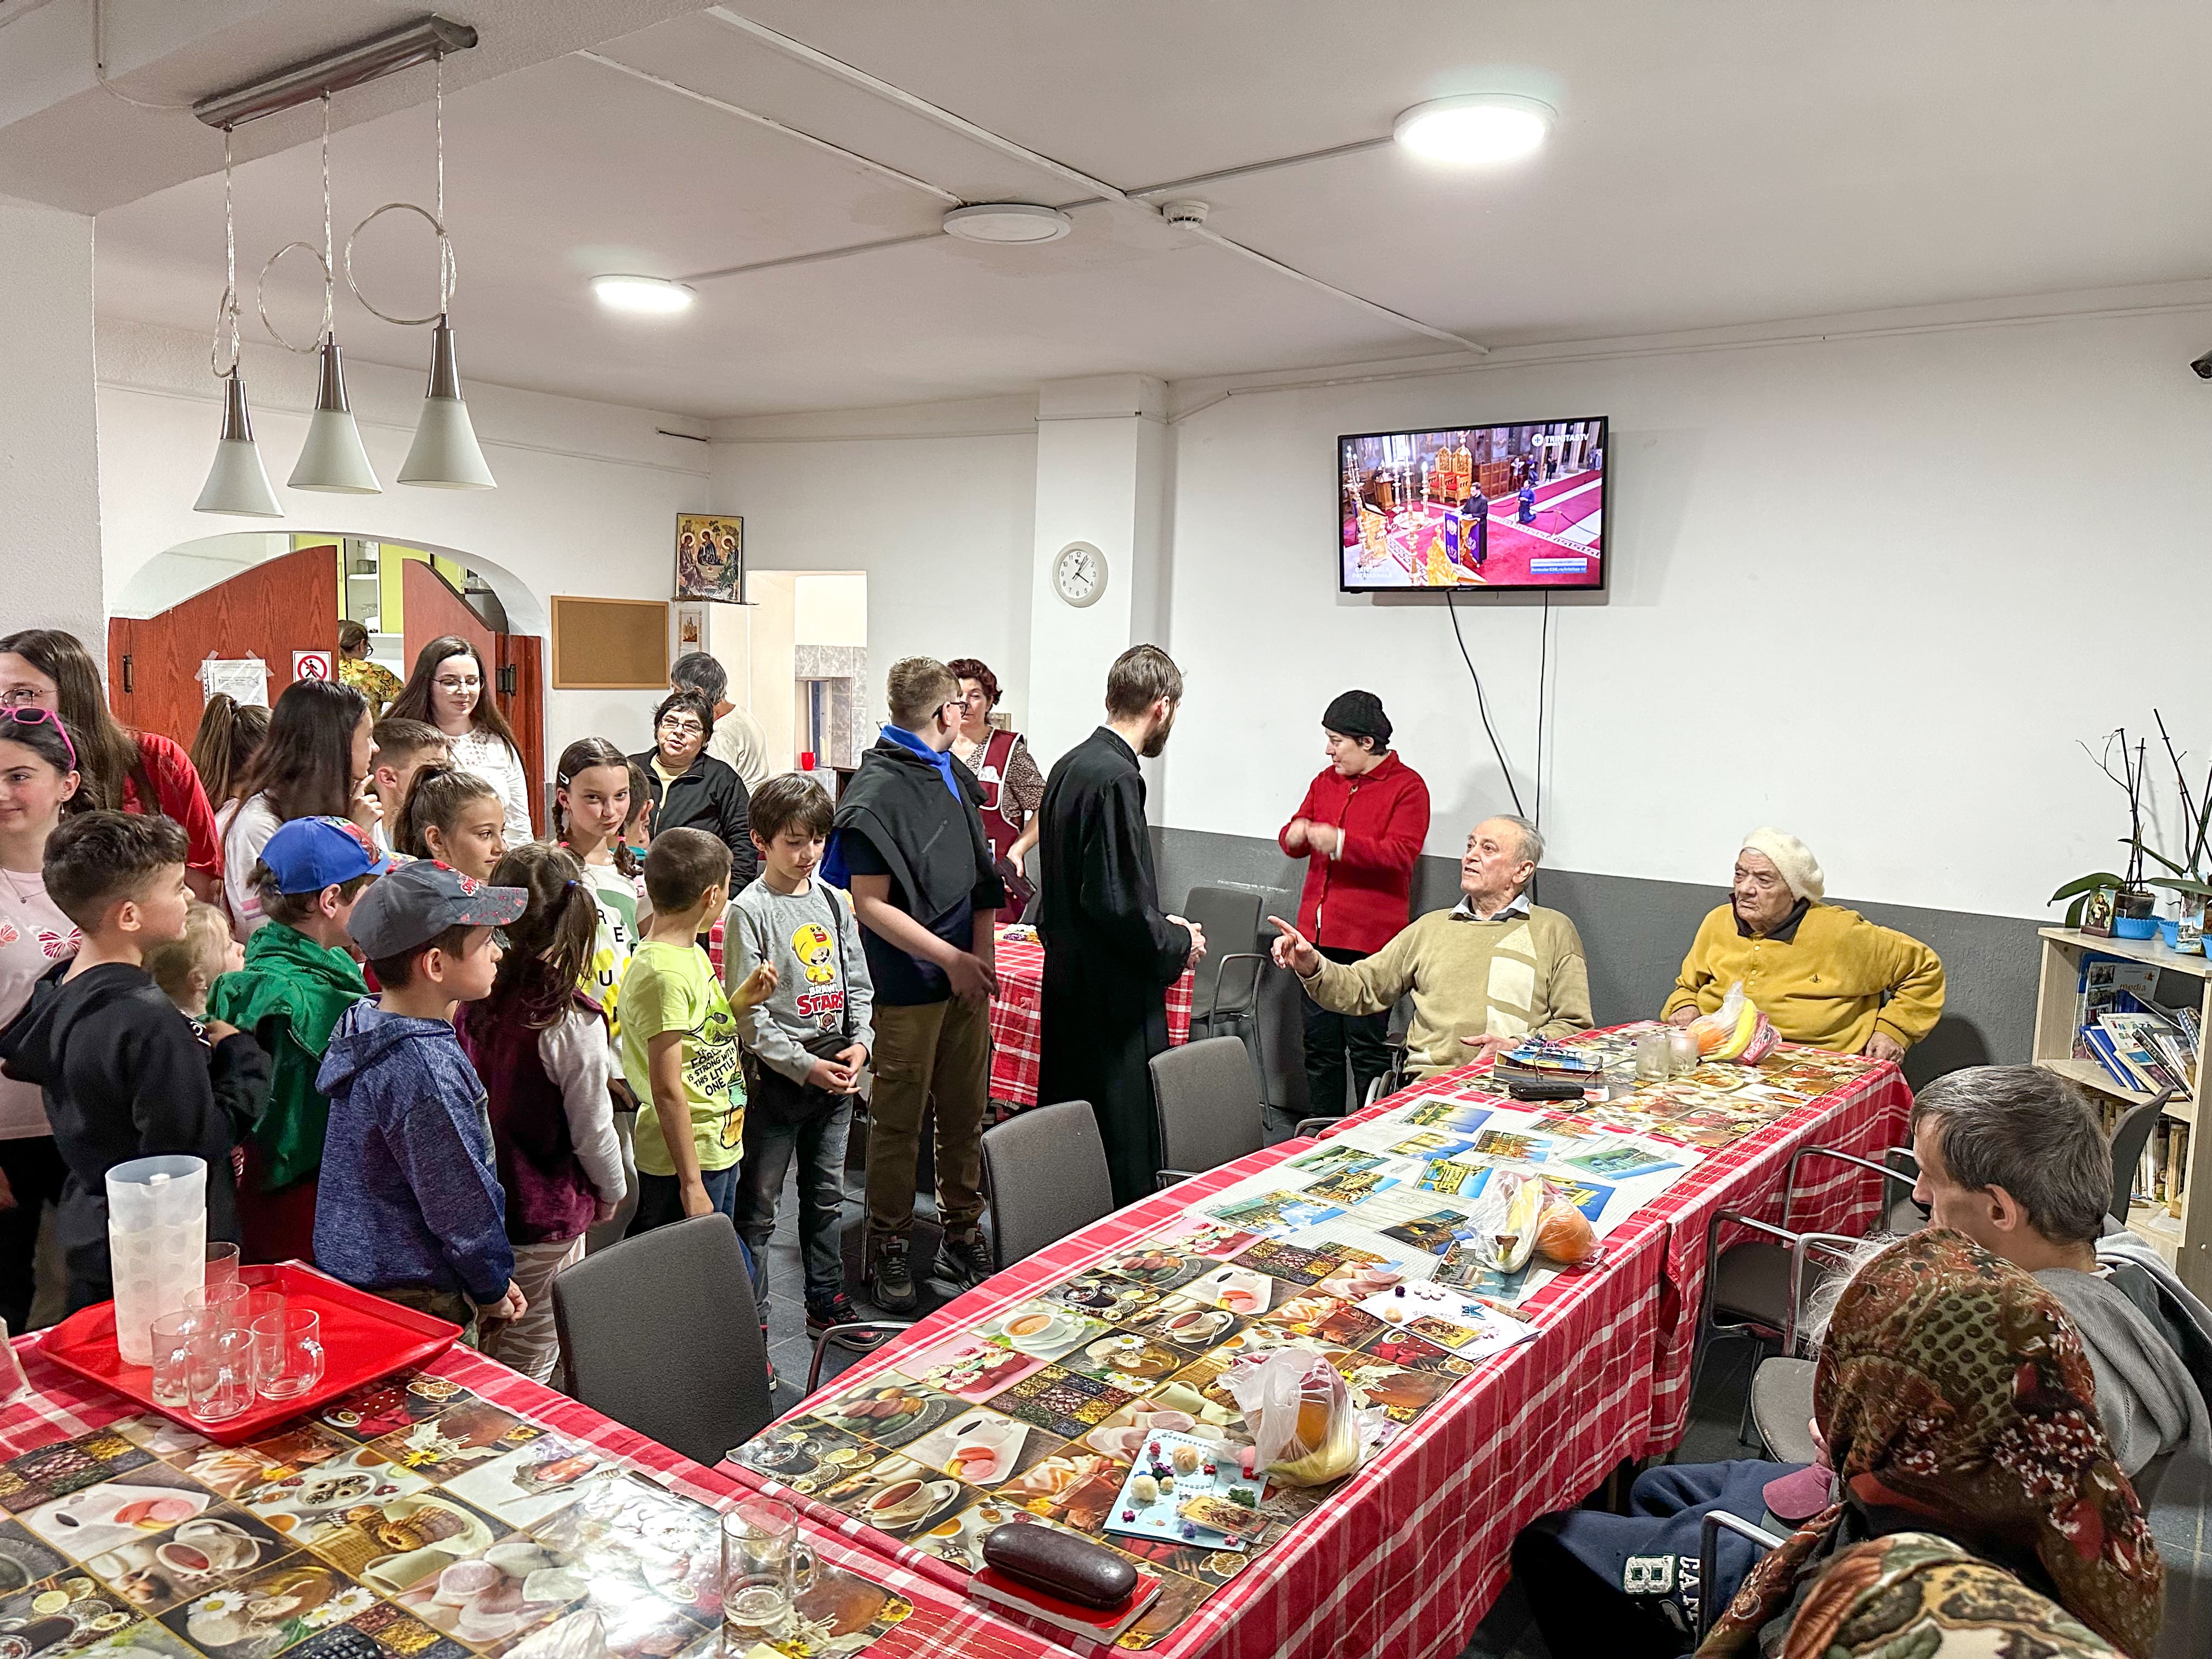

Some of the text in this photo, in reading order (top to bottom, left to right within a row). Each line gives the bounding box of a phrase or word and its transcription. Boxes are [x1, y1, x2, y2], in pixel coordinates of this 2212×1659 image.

[613, 927, 624, 942] E
[599, 970, 613, 986] U
[808, 983, 839, 996] BRAWL
[797, 990, 844, 1015] STARS
[687, 1046, 735, 1082] IS STRONG WITH
[693, 1057, 736, 1087] THIS LITTLE
[705, 1077, 726, 1096] ONE
[1622, 1554, 1676, 1594] B
